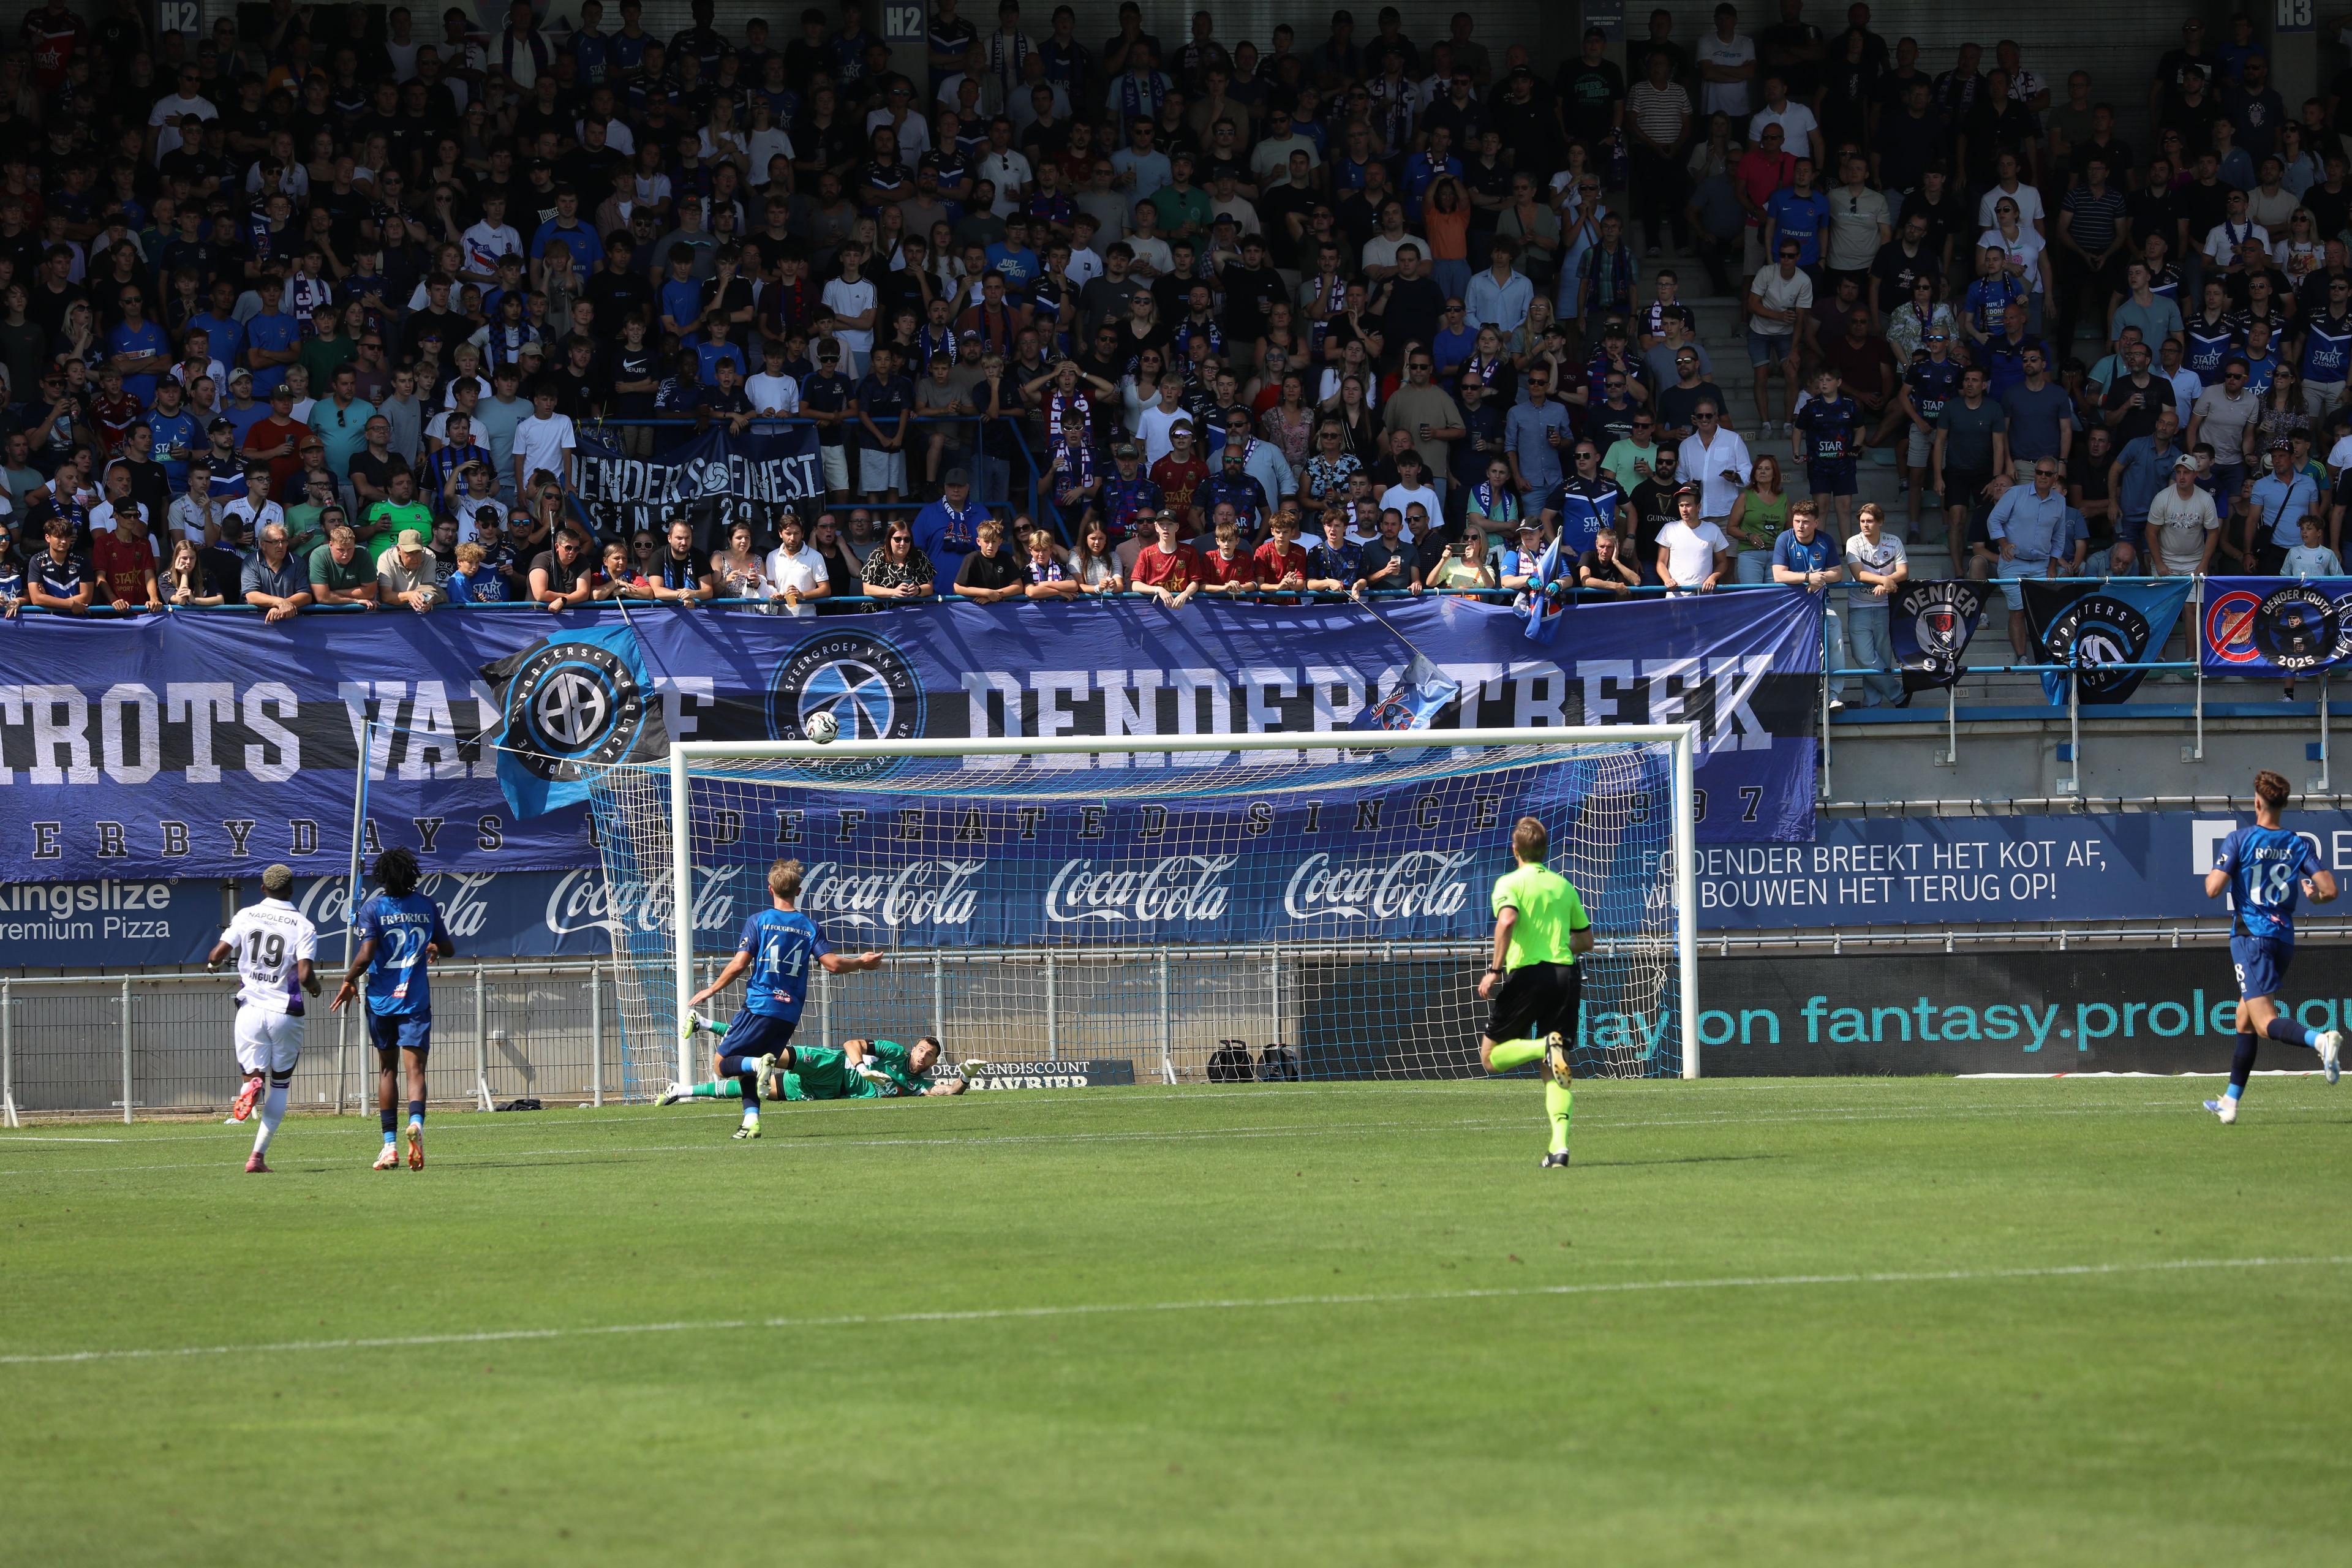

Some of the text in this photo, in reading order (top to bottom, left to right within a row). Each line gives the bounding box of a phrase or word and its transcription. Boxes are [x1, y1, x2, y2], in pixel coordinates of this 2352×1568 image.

[160, 2, 198, 32] H2
[886, 7, 921, 36] H2
[2278, 0, 2312, 26] H3
[1000, 258, 1018, 268] JUST
[2312, 358, 2337, 369] CASINO
[1819, 440, 1843, 451] STAR
[724, 453, 813, 503] FINEST
[472, 582, 501, 594] STAR
[1903, 582, 1979, 617] DENDER
[2262, 589, 2334, 617] DENDER YOUTH
[785, 643, 857, 691] SFEERGROEP
[867, 647, 892, 669] VAK
[2277, 655, 2316, 668] 2025
[1246, 794, 1499, 836] SINCE
[1814, 842, 1925, 873] BREEKT
[1934, 842, 1991, 870] HET
[2001, 840, 2059, 869] KOT
[2065, 839, 2106, 872] AF,
[1046, 854, 1240, 922] Coca-Cola
[1284, 850, 1477, 920] Coca-Cola
[1702, 879, 1828, 908] BOUWEN
[1839, 878, 1899, 905] HET
[1906, 876, 2001, 904] TERUG
[2010, 873, 2057, 902] OP!
[2249, 863, 2292, 906] 18
[104, 916, 170, 940] Pizza
[248, 911, 298, 927] NAPOLEON
[380, 911, 431, 925] FREDRICK
[771, 924, 812, 937] FOUGEROLLES
[246, 928, 286, 970] 19
[383, 926, 426, 970] 22
[758, 934, 804, 978] 44
[249, 970, 279, 984] ANGULO
[1578, 1000, 1670, 1060] lay
[1698, 1008, 1781, 1045] on
[931, 1061, 1090, 1076] DRAKENDISCOUNT
